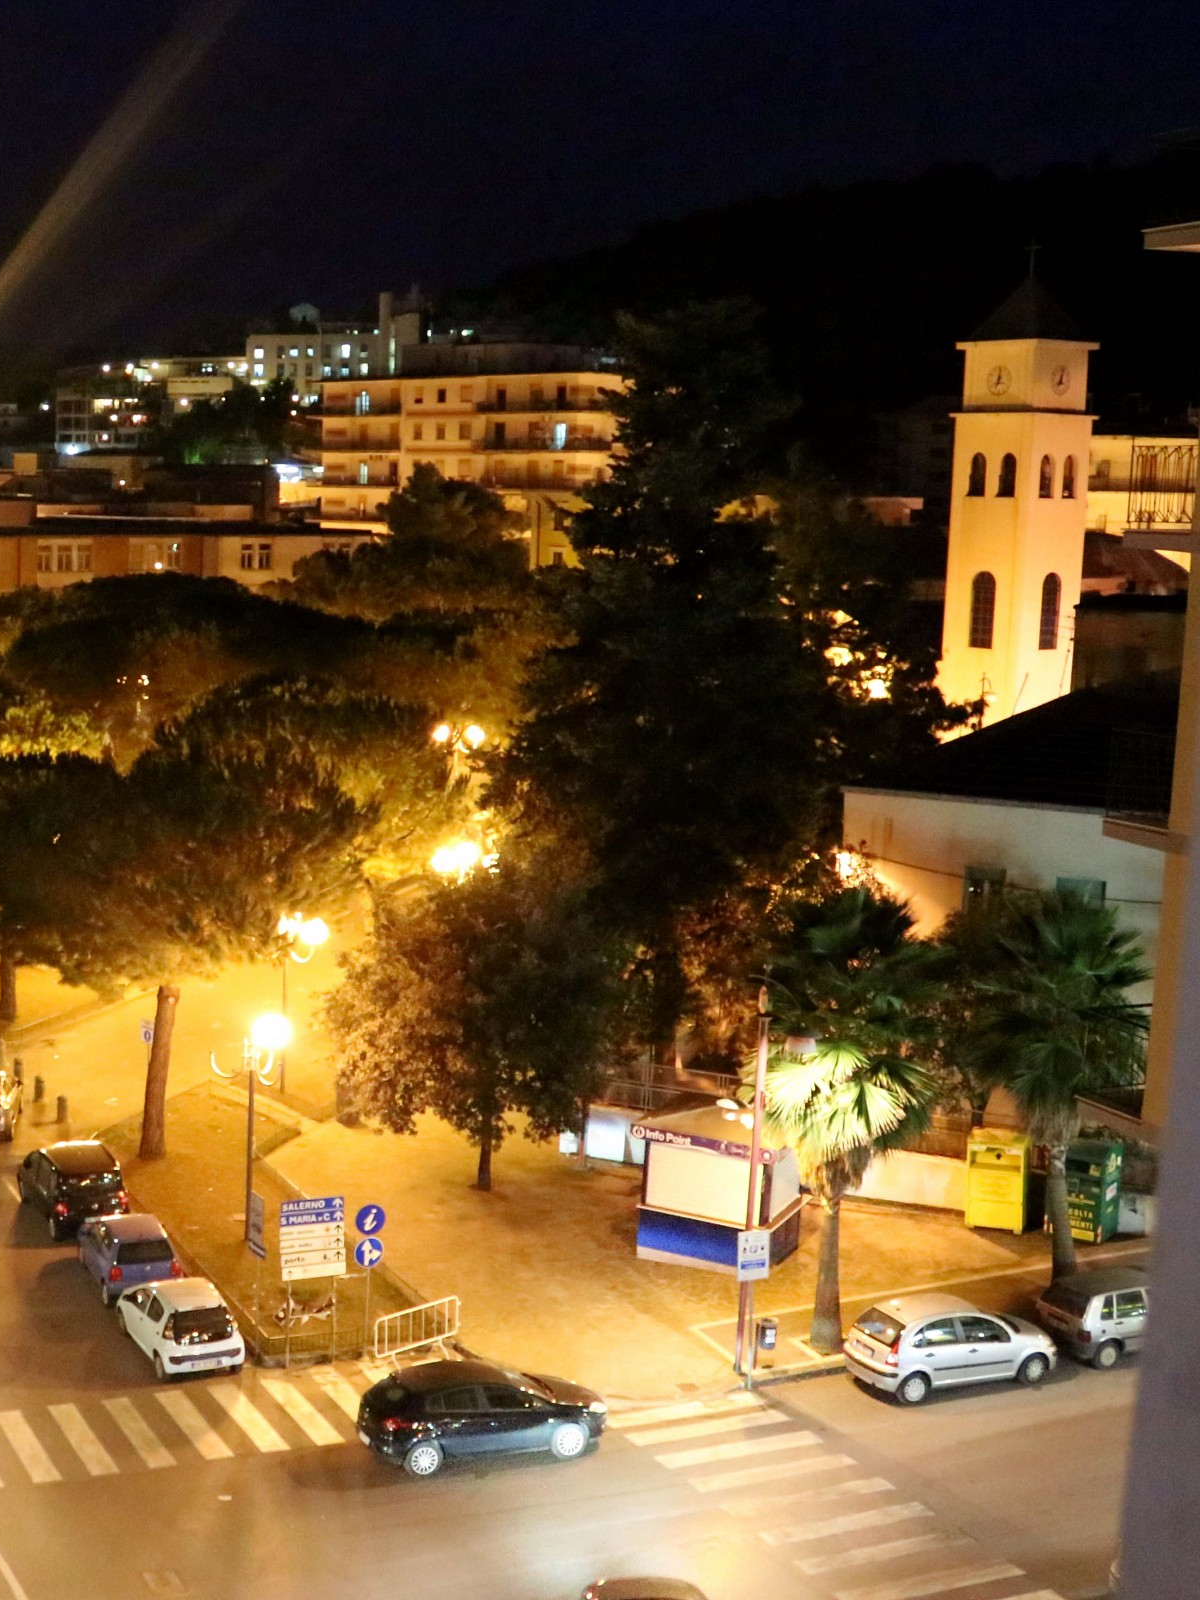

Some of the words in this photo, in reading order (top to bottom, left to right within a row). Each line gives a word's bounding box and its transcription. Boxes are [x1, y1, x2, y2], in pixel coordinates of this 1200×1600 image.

[645, 1129, 665, 1142] Info
[666, 1133, 691, 1146] Point
[282, 1200, 325, 1212] SALERNO
[280, 1217, 287, 1225] S
[288, 1214, 317, 1224] MARIA
[323, 1213, 331, 1221] C
